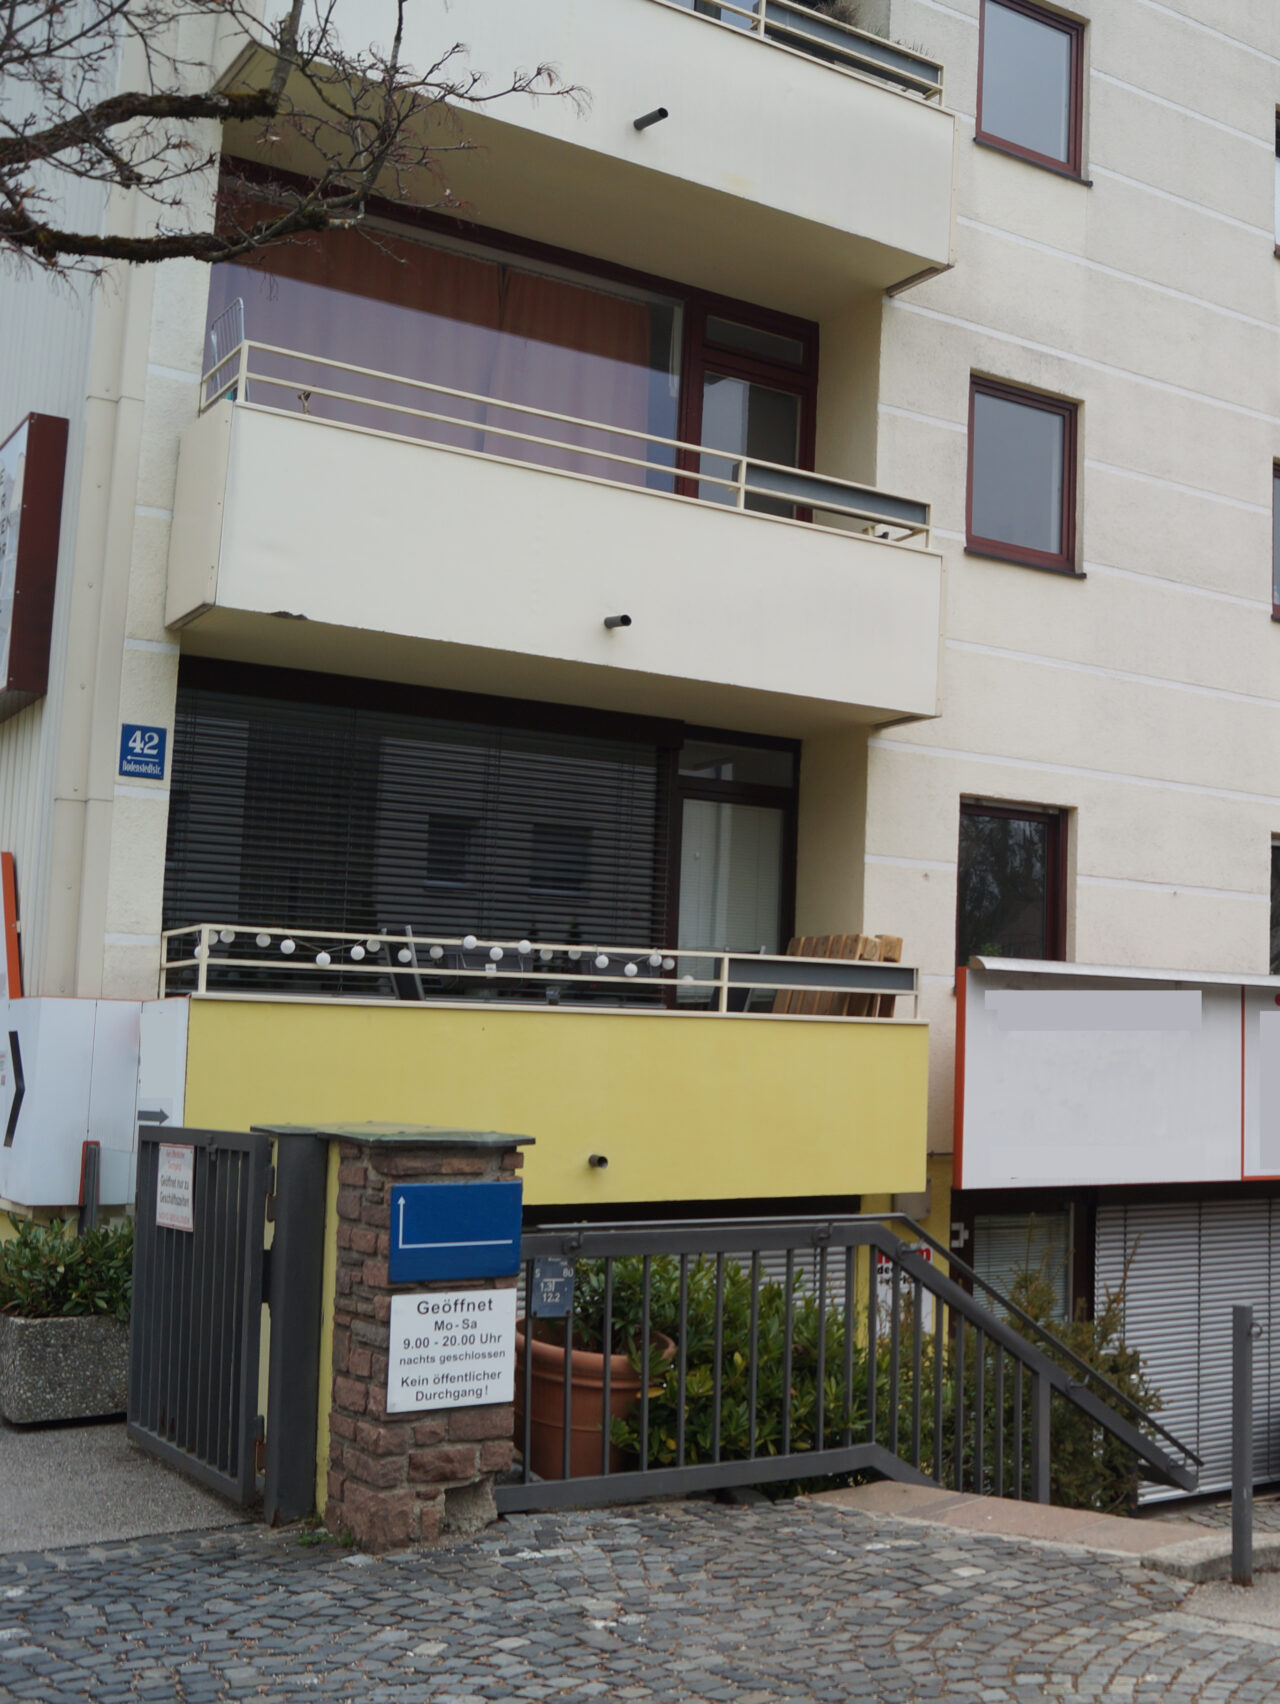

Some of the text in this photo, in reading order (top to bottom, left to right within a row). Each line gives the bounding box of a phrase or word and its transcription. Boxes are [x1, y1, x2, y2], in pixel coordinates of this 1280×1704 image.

[128, 730, 159, 755] 42
[417, 1298, 493, 1315] Geöffnet
[403, 1337, 430, 1350] 9.00
[442, 1334, 476, 1347] 20.00
[480, 1332, 503, 1345] Uhr
[399, 1350, 506, 1366] nachts geschlossen
[401, 1370, 503, 1388] Kein öffentlicher
